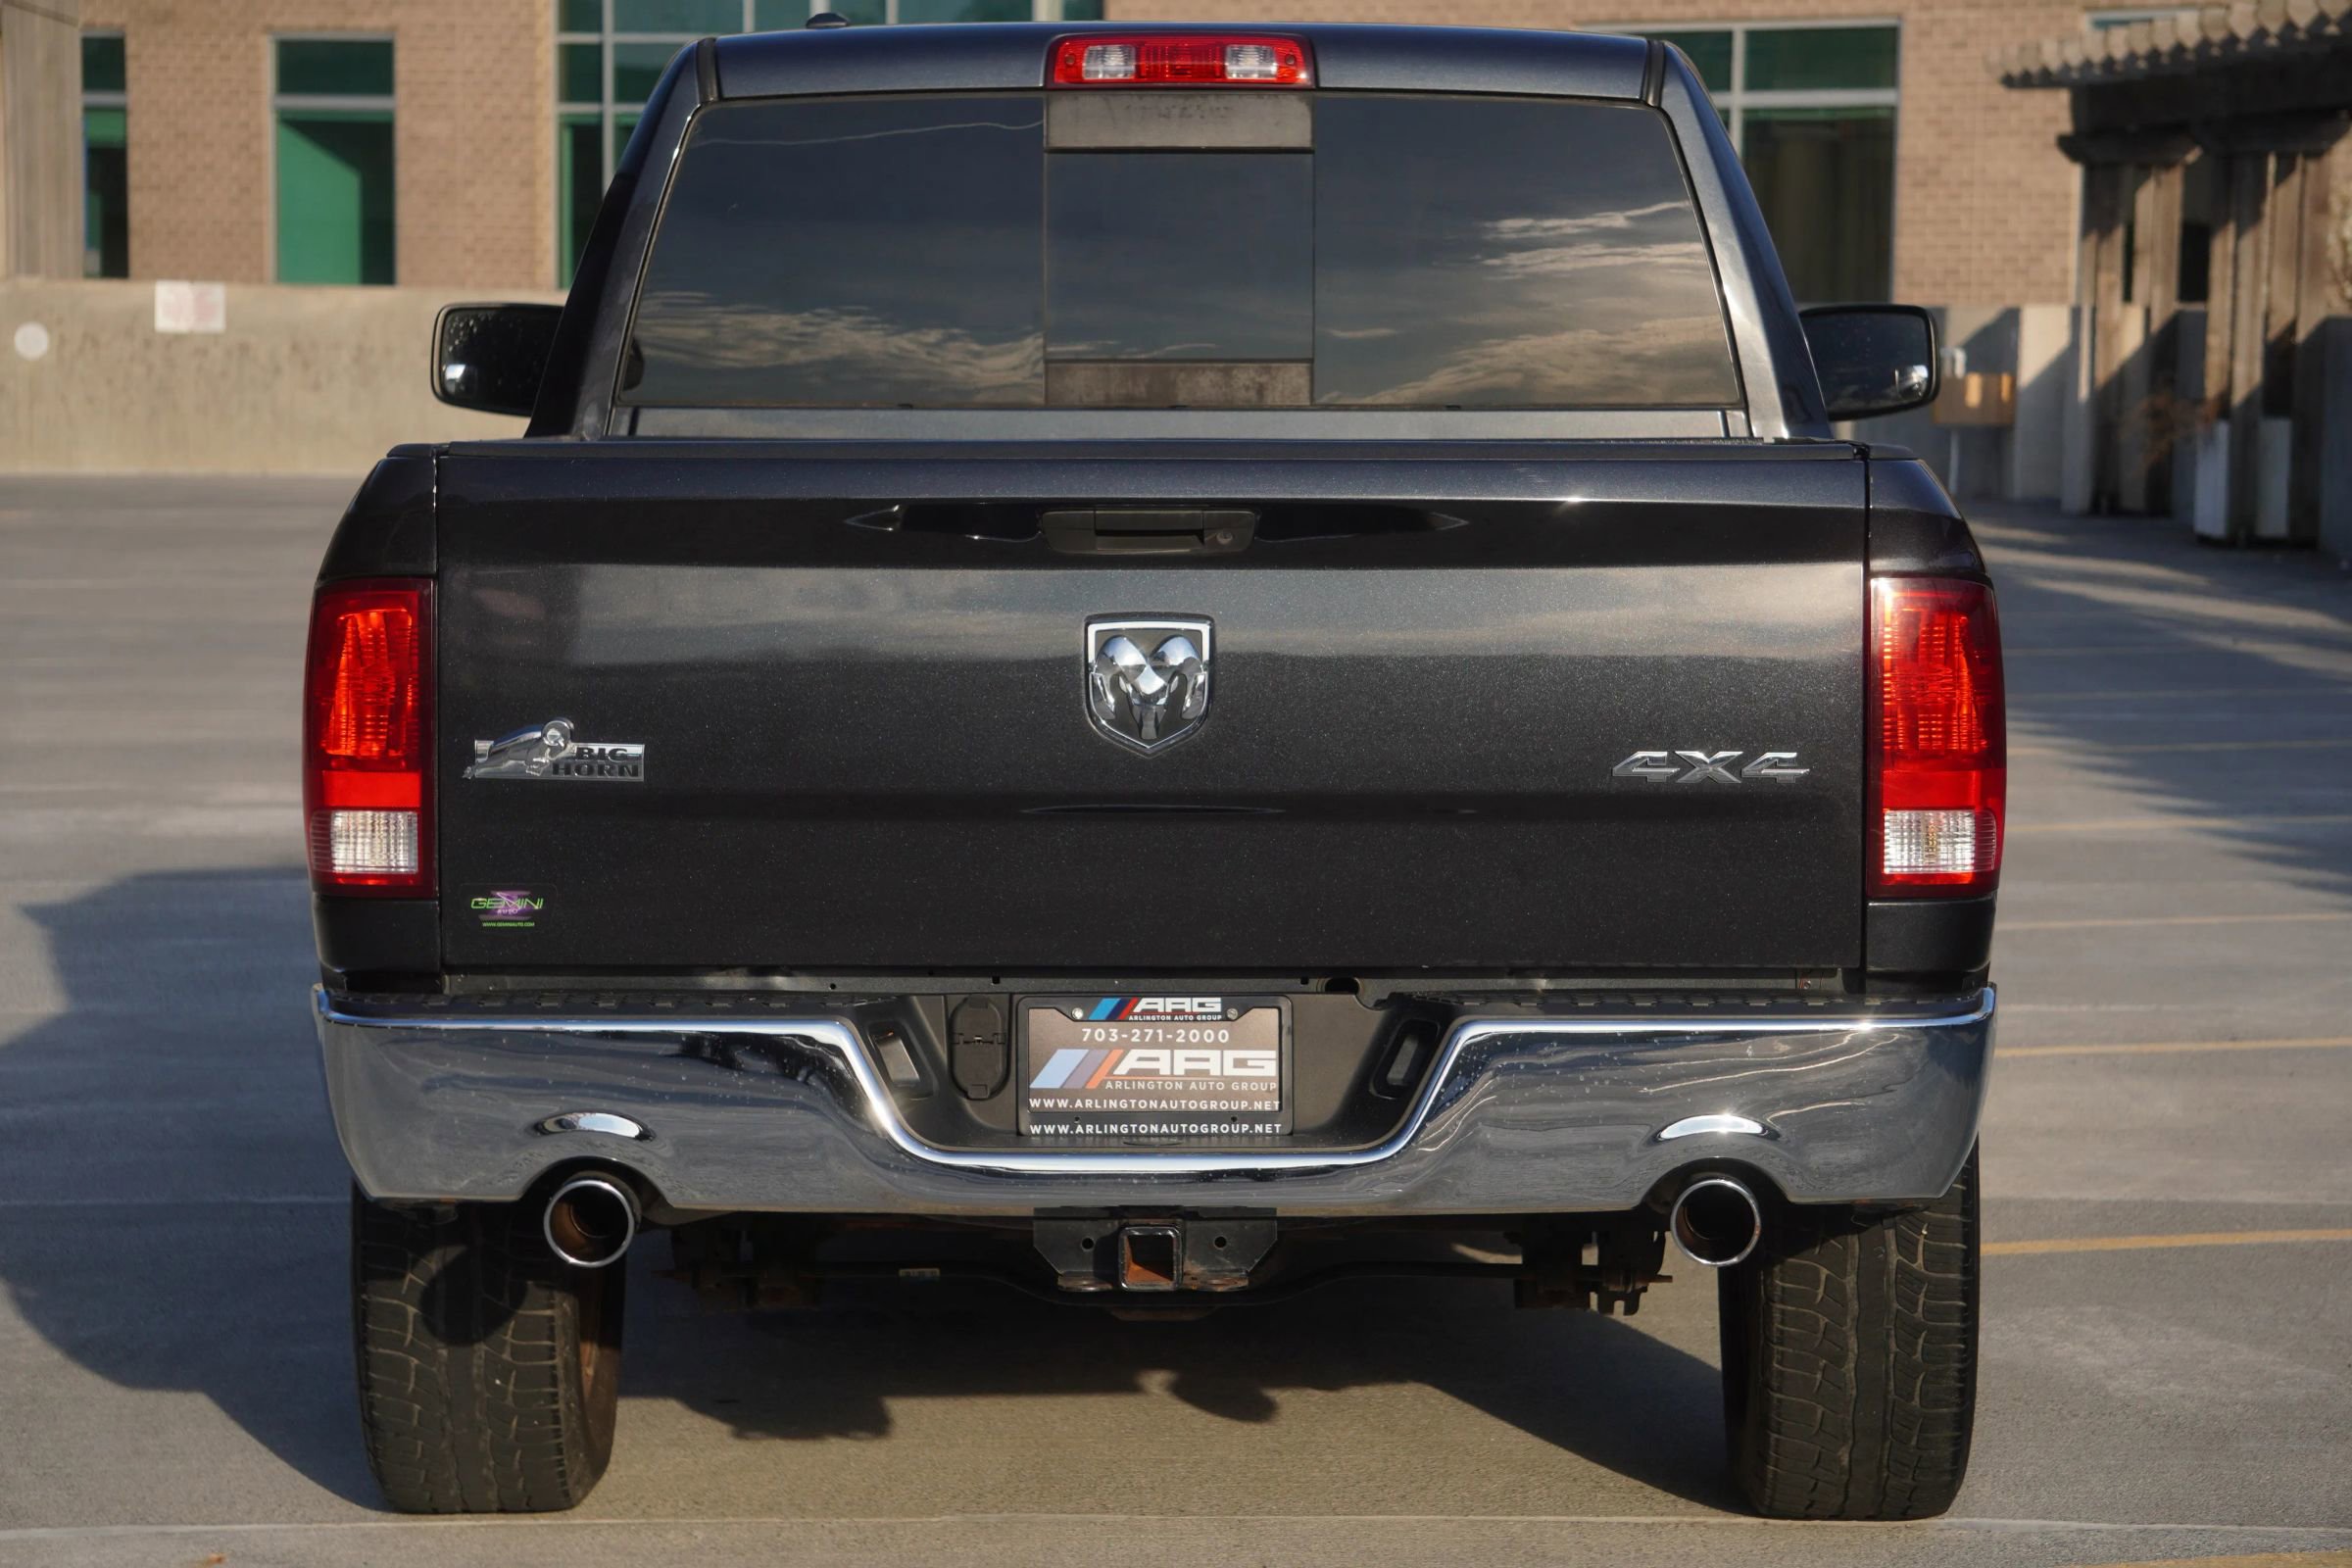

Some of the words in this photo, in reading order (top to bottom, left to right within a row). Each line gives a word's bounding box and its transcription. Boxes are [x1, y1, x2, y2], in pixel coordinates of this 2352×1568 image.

[574, 747, 636, 763] BIG
[552, 763, 639, 778] HORN
[1611, 751, 1810, 784] 4X4
[470, 898, 544, 909] GEMINI
[1133, 998, 1222, 1012] AAG
[1082, 1028, 1230, 1044] 703-271-2000
[1112, 1049, 1277, 1077] AAG
[1104, 1080, 1183, 1091] ARLINGTON
[1189, 1081, 1225, 1091] AUTO
[1231, 1081, 1277, 1092] GROUP
[1028, 1098, 1281, 1110] WWW.ARLINGTONAUTOGROUP.NET
[1029, 1123, 1283, 1135] WWW.ARLINGTONAUTOGROUP.NET
